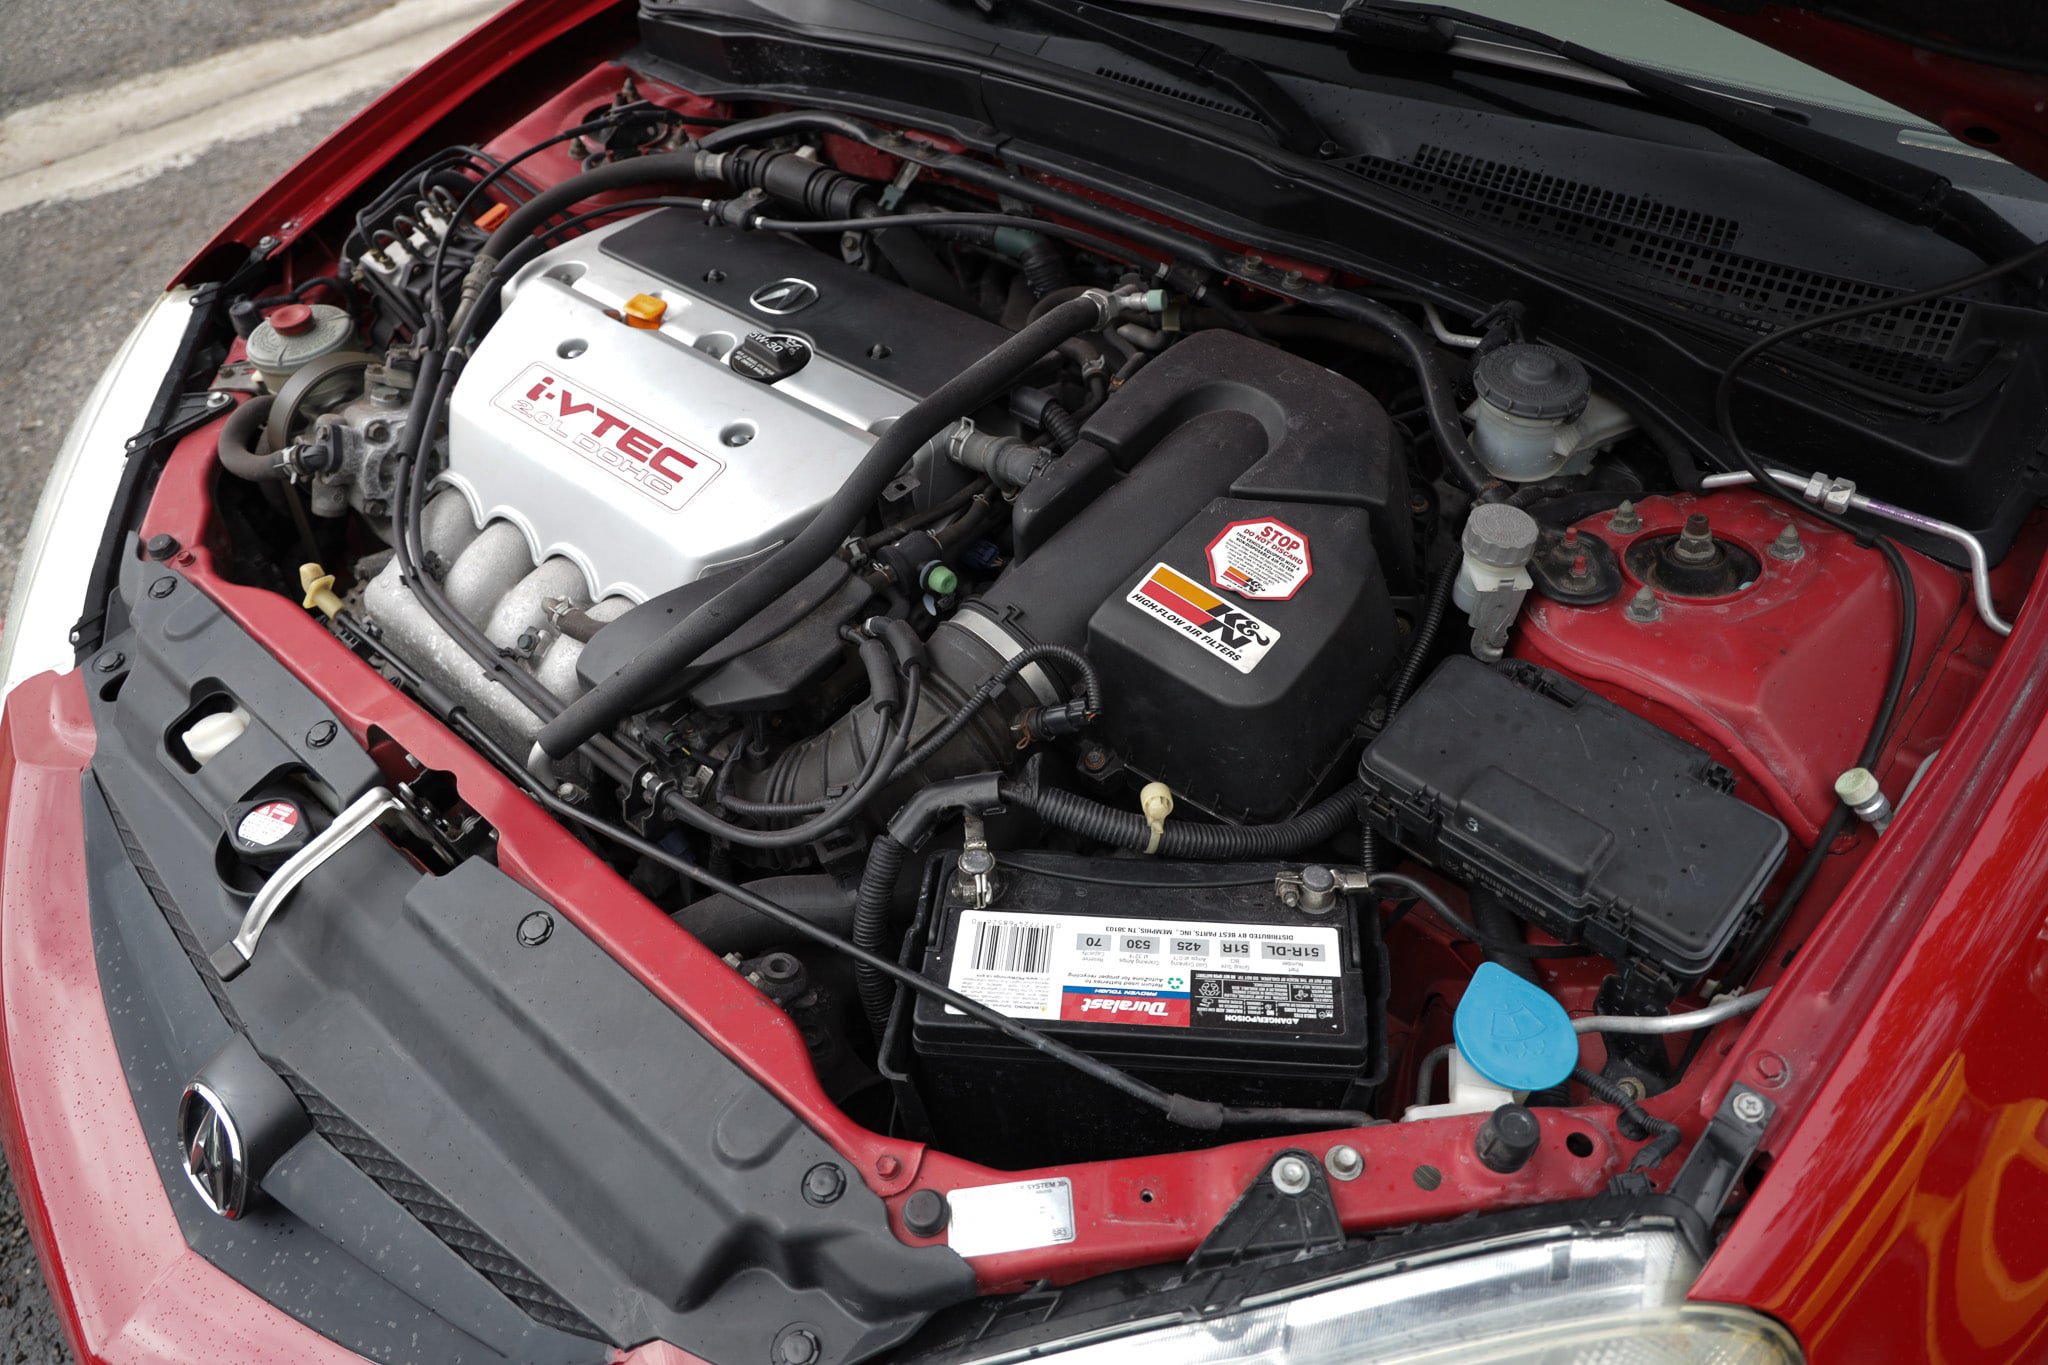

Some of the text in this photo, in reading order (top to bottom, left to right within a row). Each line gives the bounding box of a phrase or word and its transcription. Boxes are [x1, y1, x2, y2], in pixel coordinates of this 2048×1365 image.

[749, 330, 783, 352] 5W-30
[526, 376, 698, 483] i-VTEC
[511, 399, 673, 496] 2.0L DOHC
[1244, 528, 1254, 537] DO
[1255, 535, 1271, 546] NOT
[1271, 544, 1303, 565] DISCARD
[1261, 526, 1300, 551] STOP
[1236, 532, 1246, 540] THIS
[1247, 537, 1264, 550] VEHICLE
[1264, 547, 1285, 562] EQUIPPED
[1285, 559, 1296, 569] WITH
[1236, 537, 1271, 560] NON-DISPOSABLE
[1271, 556, 1279, 564] AIR
[1279, 561, 1294, 573] FILTER
[1132, 593, 1242, 661] HIGH-FLOW AIR FILTERS
[1086, 937, 1101, 947] 70
[1127, 939, 1150, 949] 530
[1177, 942, 1201, 951] 425
[1223, 943, 1249, 953] 51R
[1267, 945, 1319, 957] 51R-DL
[1081, 998, 1168, 1016] Duralast
[1225, 1015, 1292, 1024] DANGER/POISON
